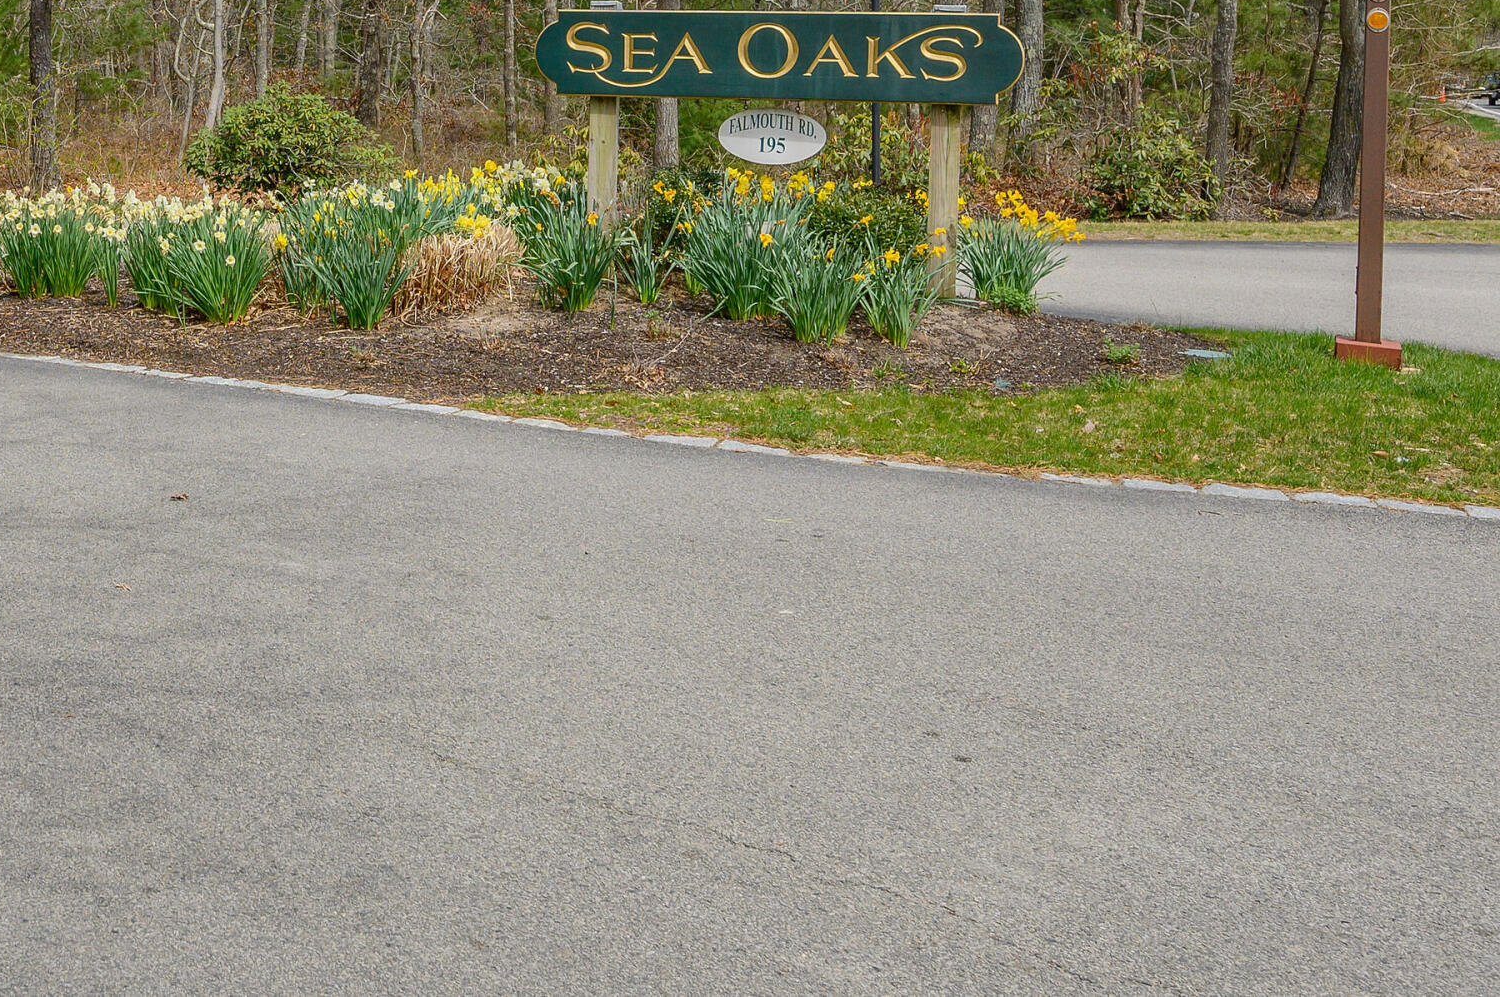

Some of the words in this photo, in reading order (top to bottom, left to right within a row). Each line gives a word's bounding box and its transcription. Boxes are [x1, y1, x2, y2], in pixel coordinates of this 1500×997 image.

[566, 21, 713, 88] SEA
[737, 21, 984, 82] OAKS
[729, 113, 794, 134] FALMOUTH
[798, 118, 817, 139] RD.
[759, 136, 786, 154] 195
